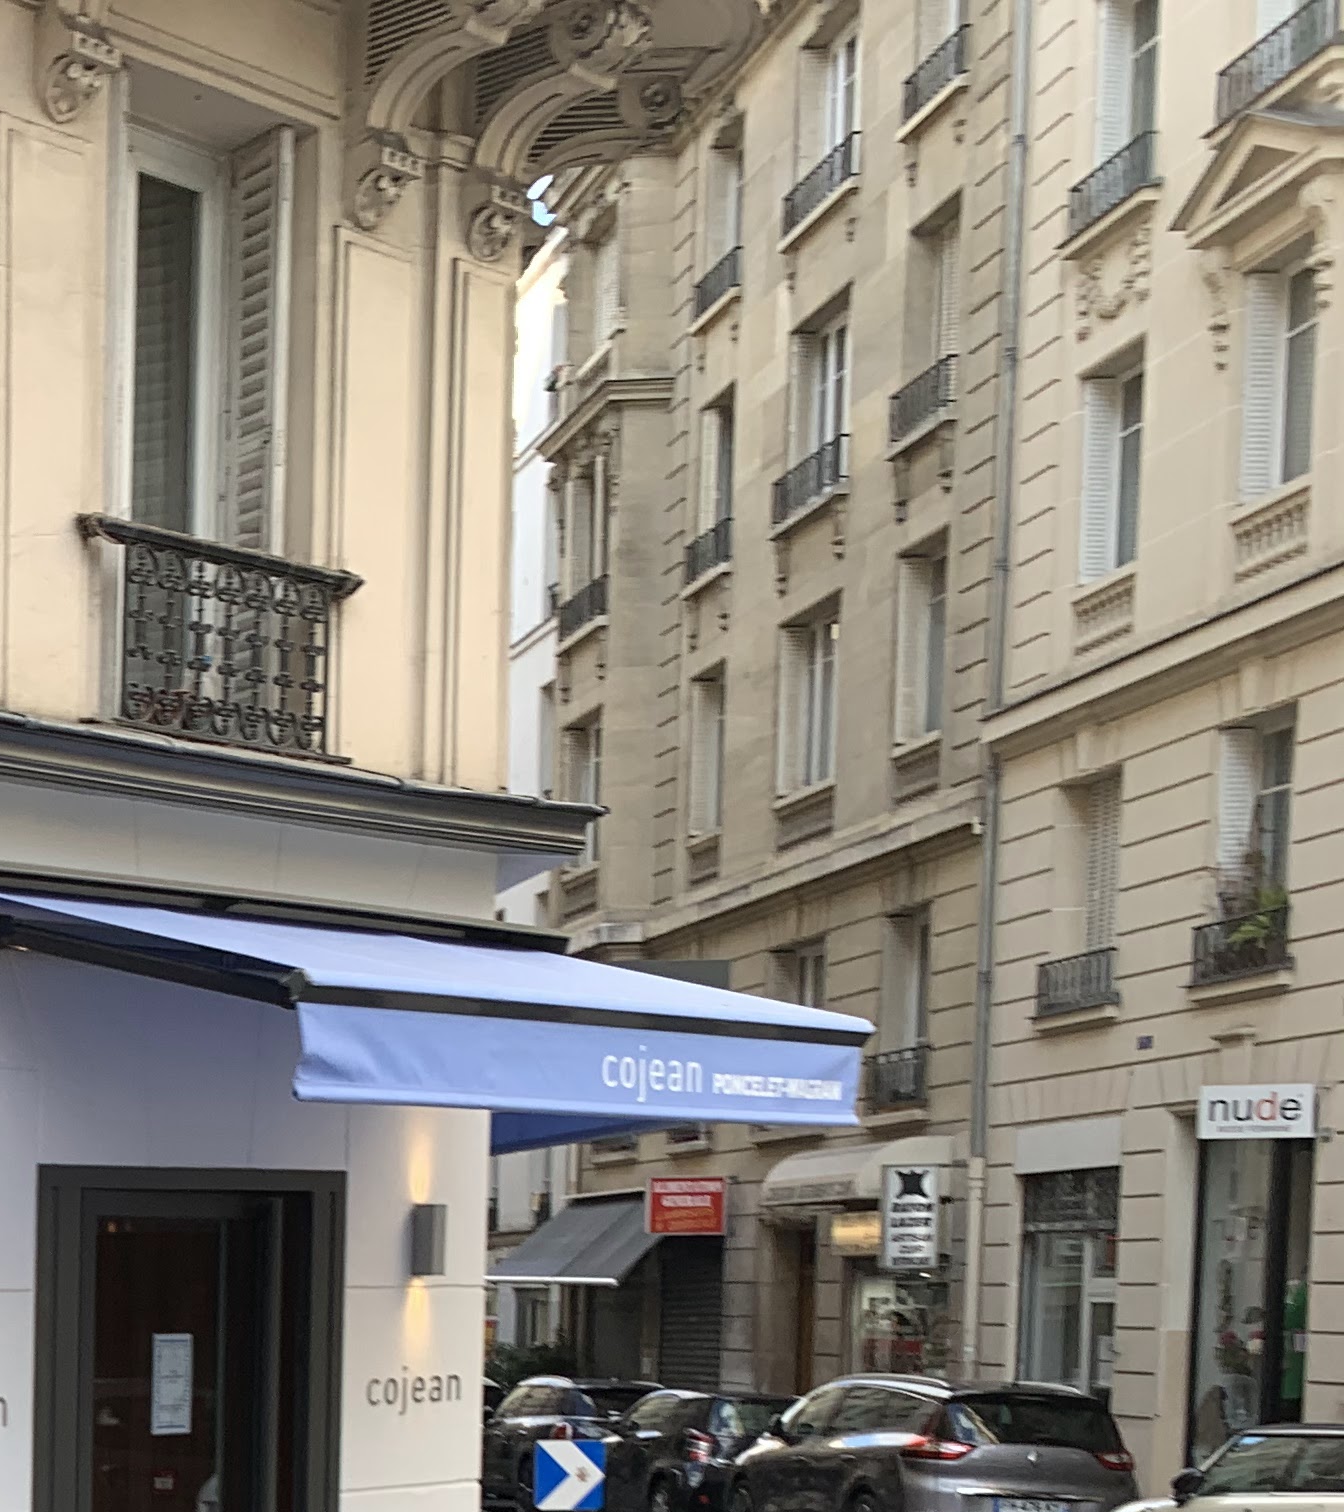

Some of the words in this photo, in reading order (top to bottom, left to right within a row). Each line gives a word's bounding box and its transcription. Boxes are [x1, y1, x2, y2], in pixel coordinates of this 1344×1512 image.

[601, 1044, 703, 1103] cojean
[1207, 1091, 1303, 1122] nude
[366, 1366, 462, 1415] cojean
